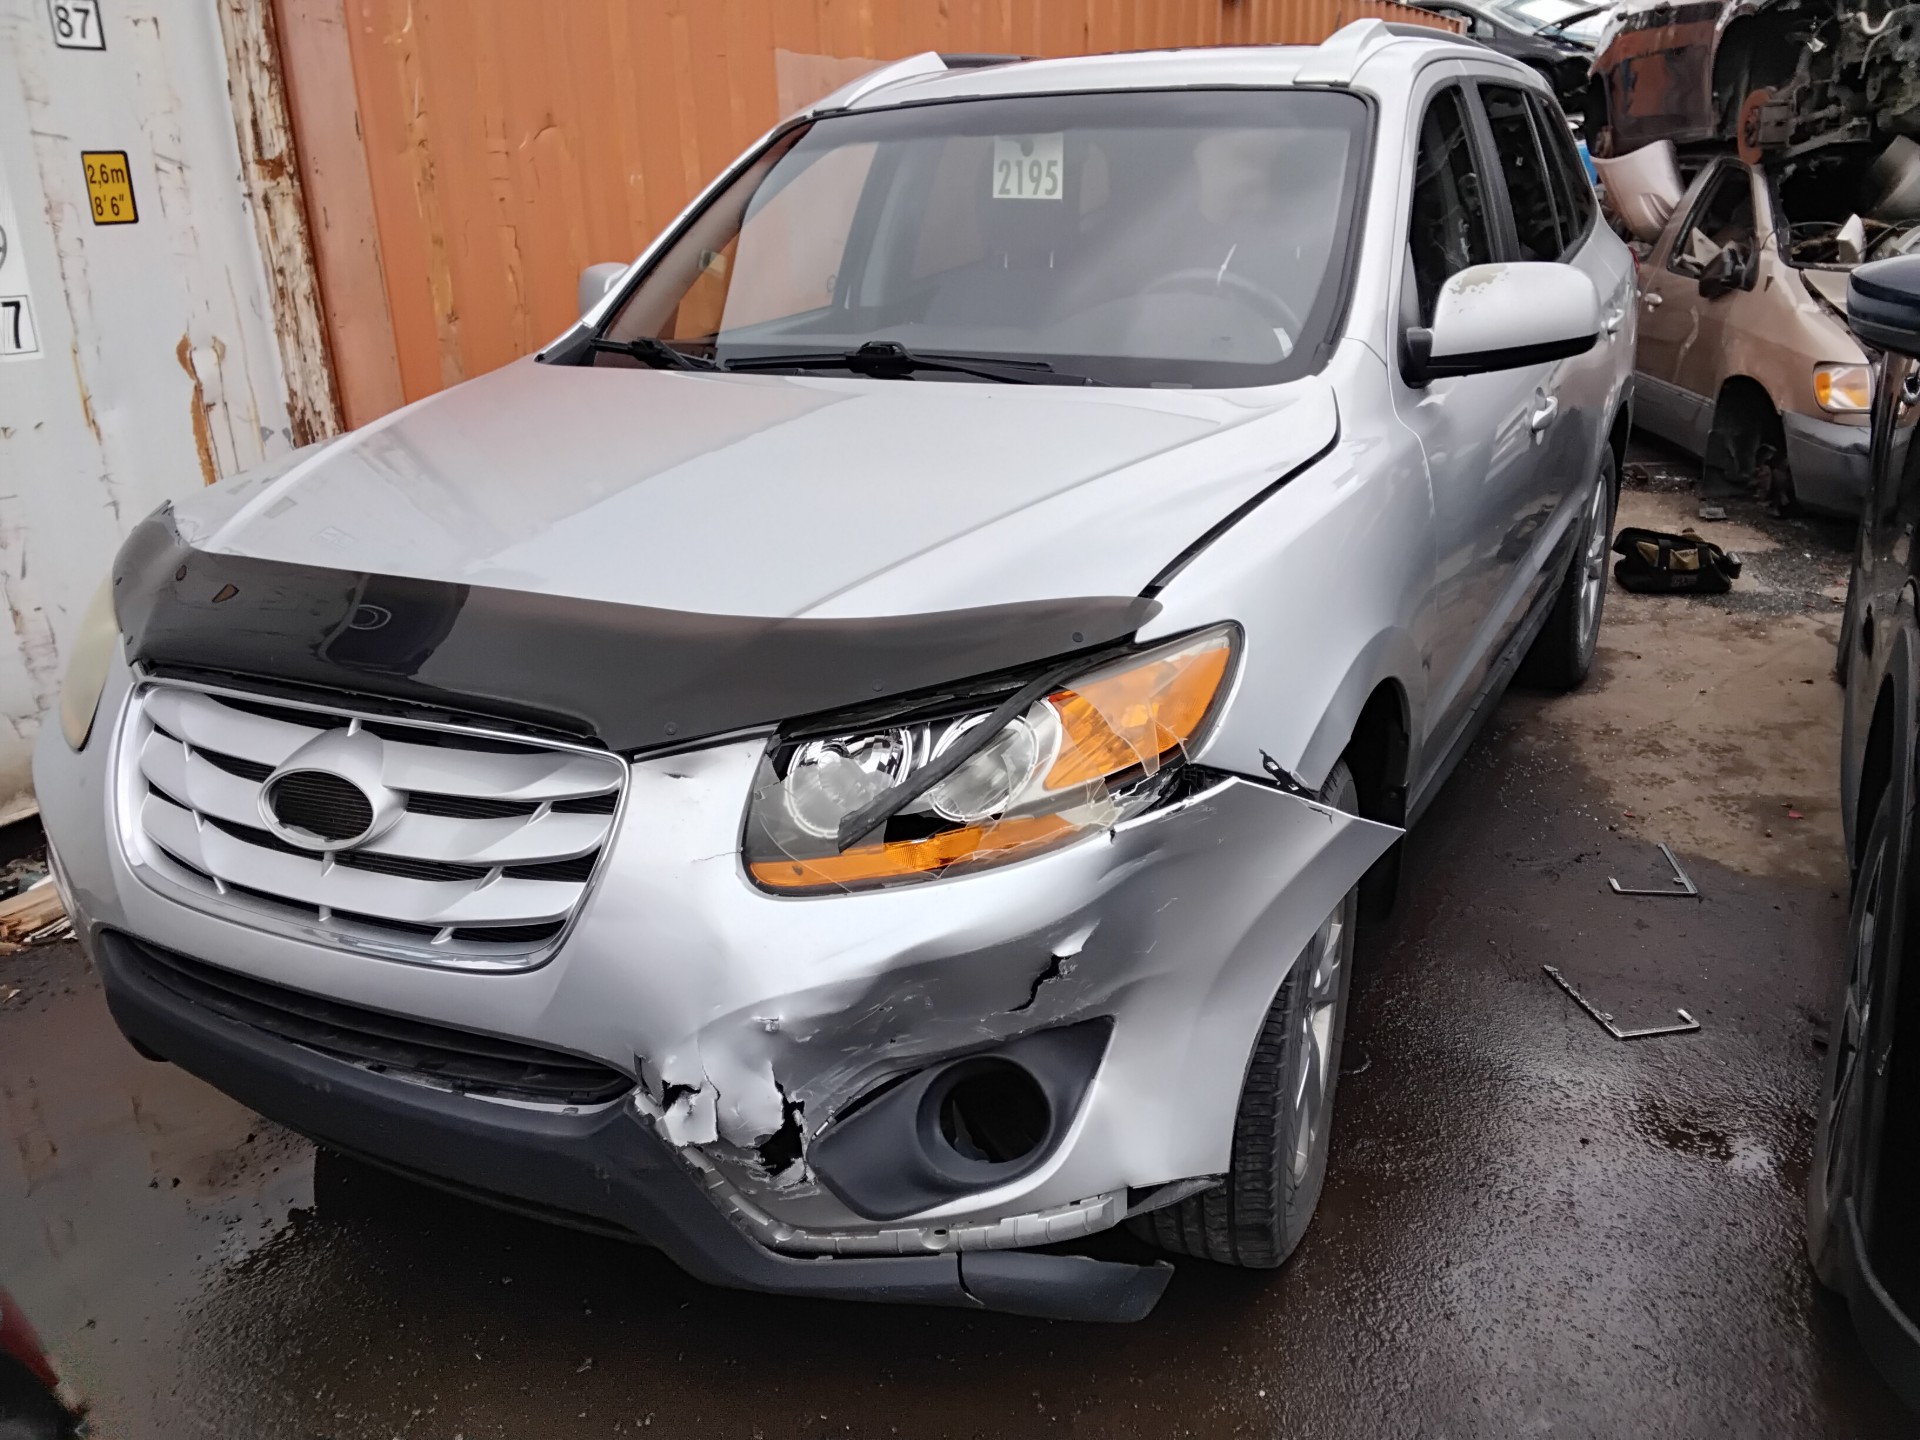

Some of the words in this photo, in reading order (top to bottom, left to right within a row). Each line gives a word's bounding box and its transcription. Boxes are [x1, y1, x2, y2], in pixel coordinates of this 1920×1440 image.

[55, 5, 89, 39] 87
[998, 159, 1058, 196] 2195
[1, 300, 21, 349] 7
